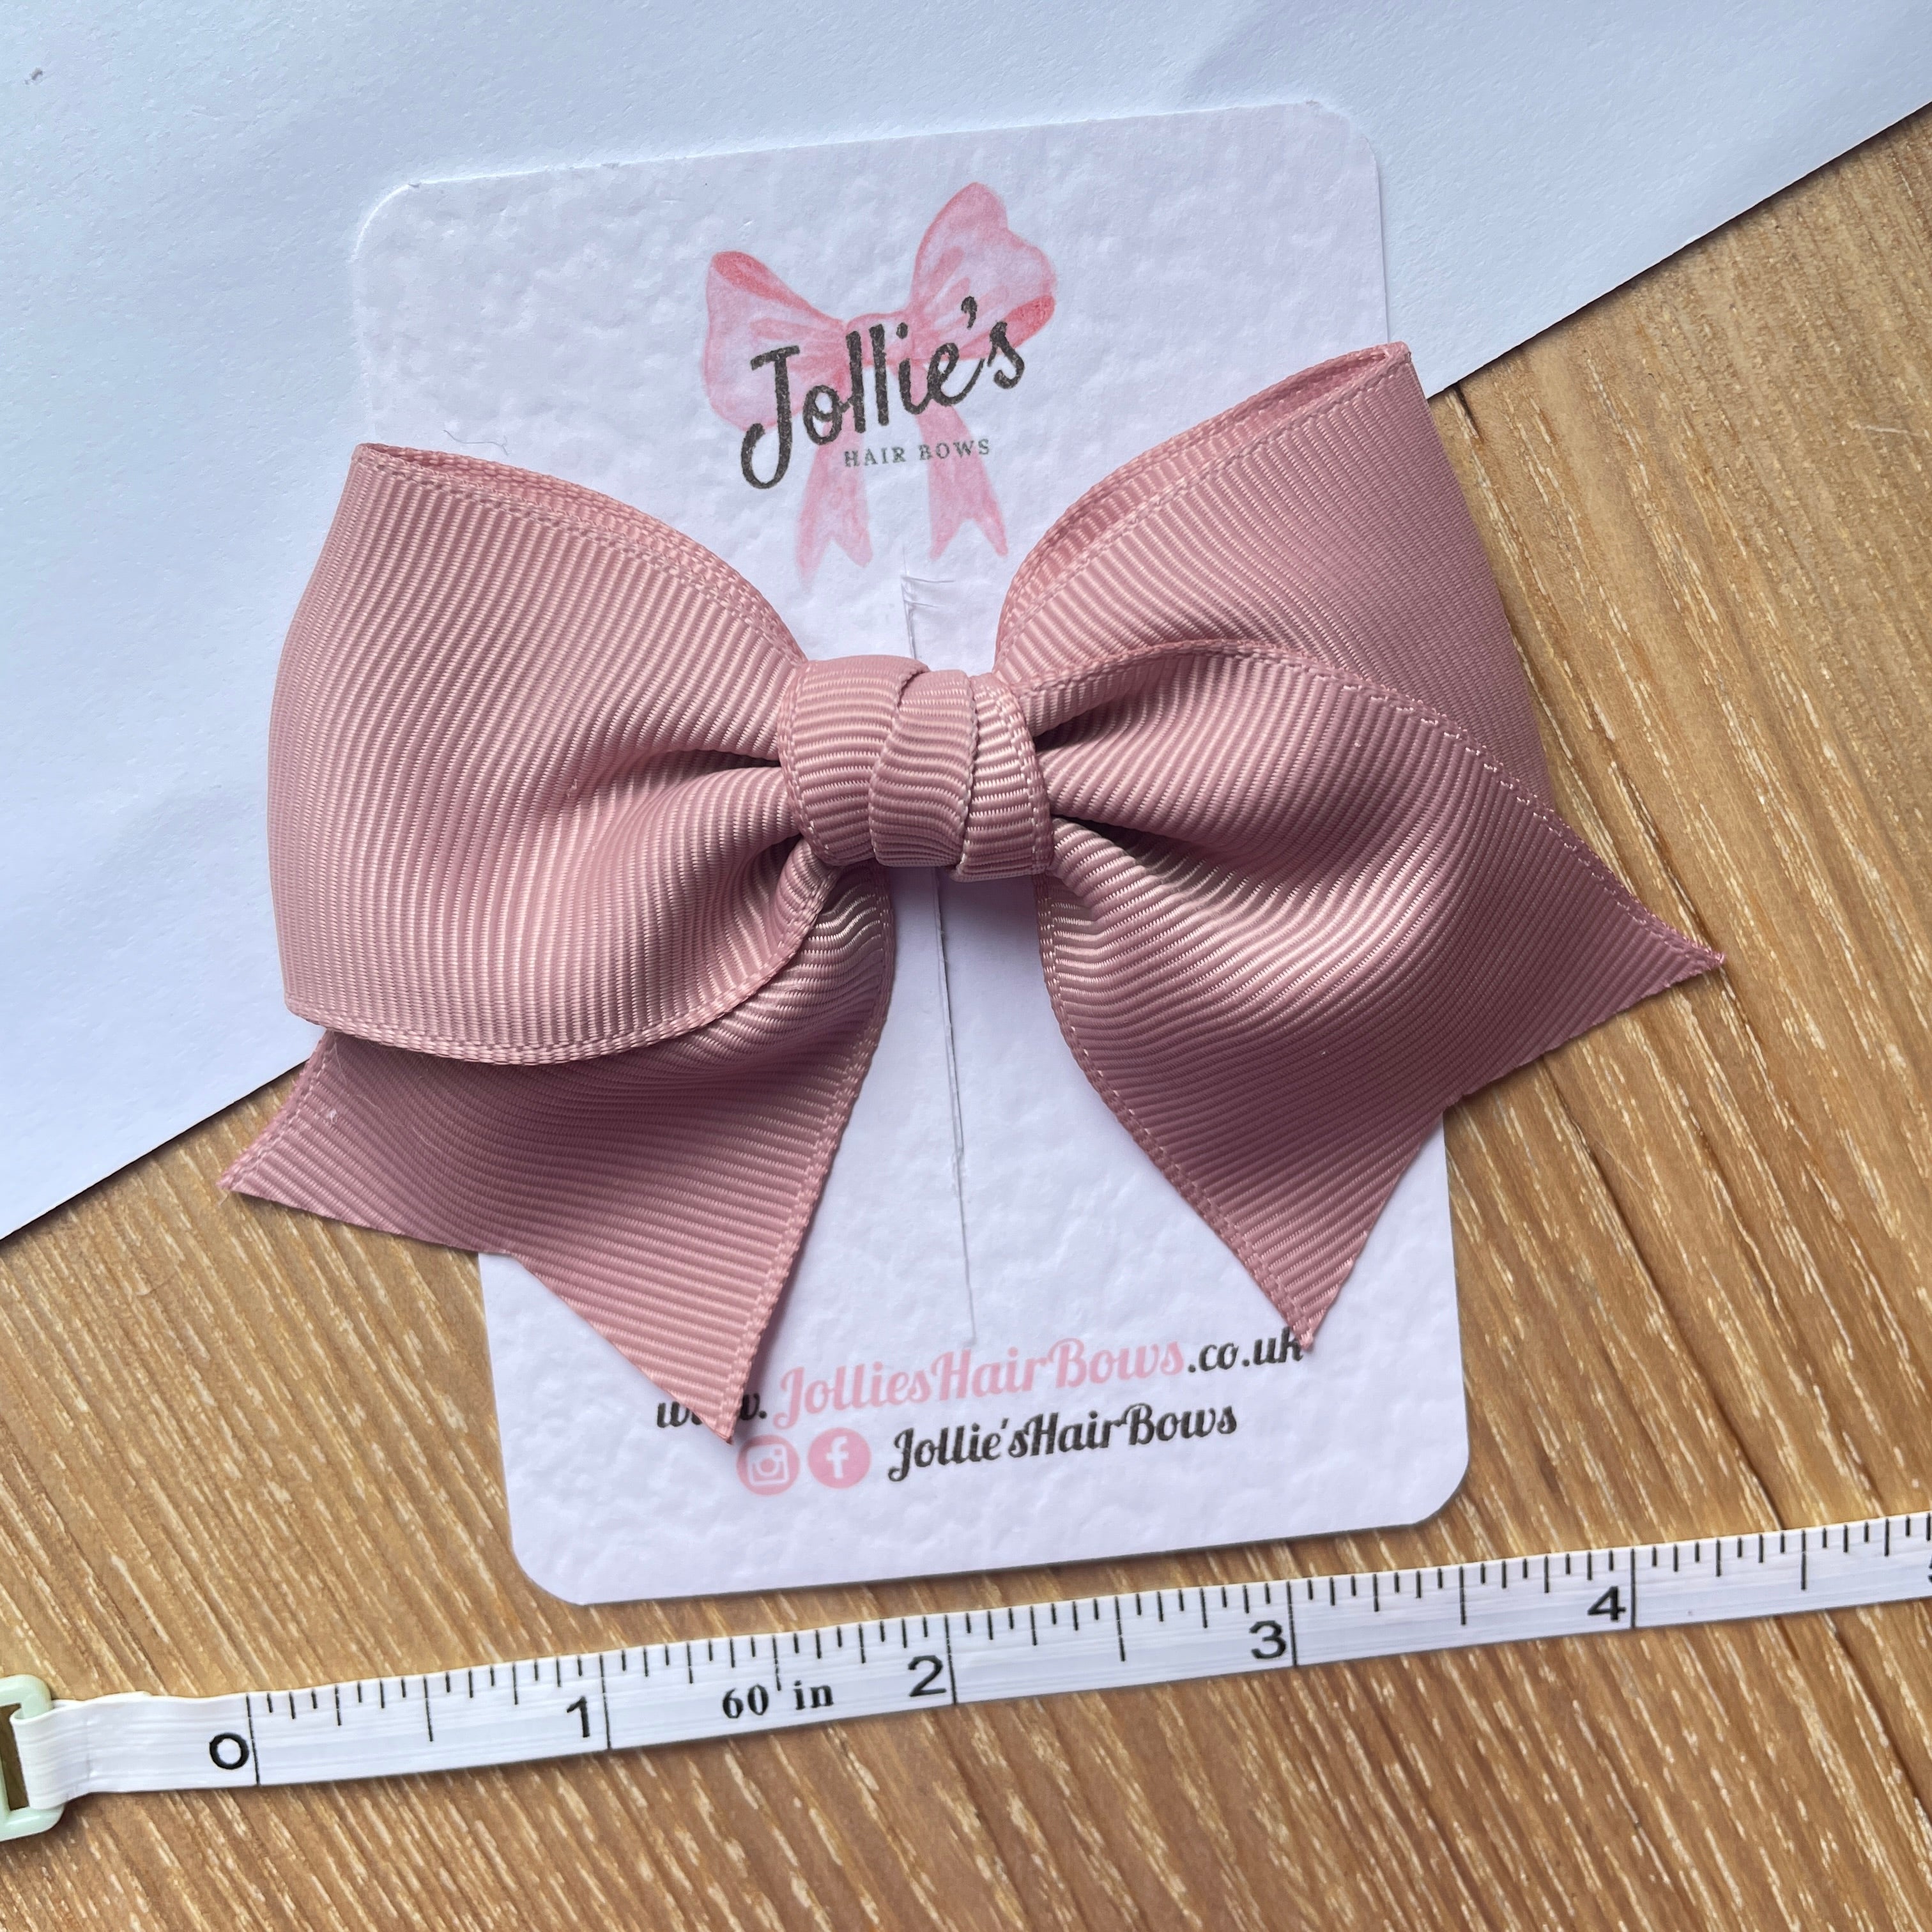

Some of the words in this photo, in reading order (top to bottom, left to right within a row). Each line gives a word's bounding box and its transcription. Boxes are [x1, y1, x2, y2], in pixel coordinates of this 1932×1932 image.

[740, 295, 1025, 489] Jollie's
[843, 446, 907, 468] HAIR
[917, 438, 991, 462] BOWS
[887, 1402, 1238, 1482] Jollie'sHairBows
[1587, 1585, 1627, 1622] 4
[1249, 1620, 1287, 1660] 3
[907, 1654, 947, 1698] 2
[565, 1696, 592, 1739] 1
[721, 1683, 770, 1719] 60
[793, 1680, 834, 1711] in
[208, 1732, 250, 1771] 0
